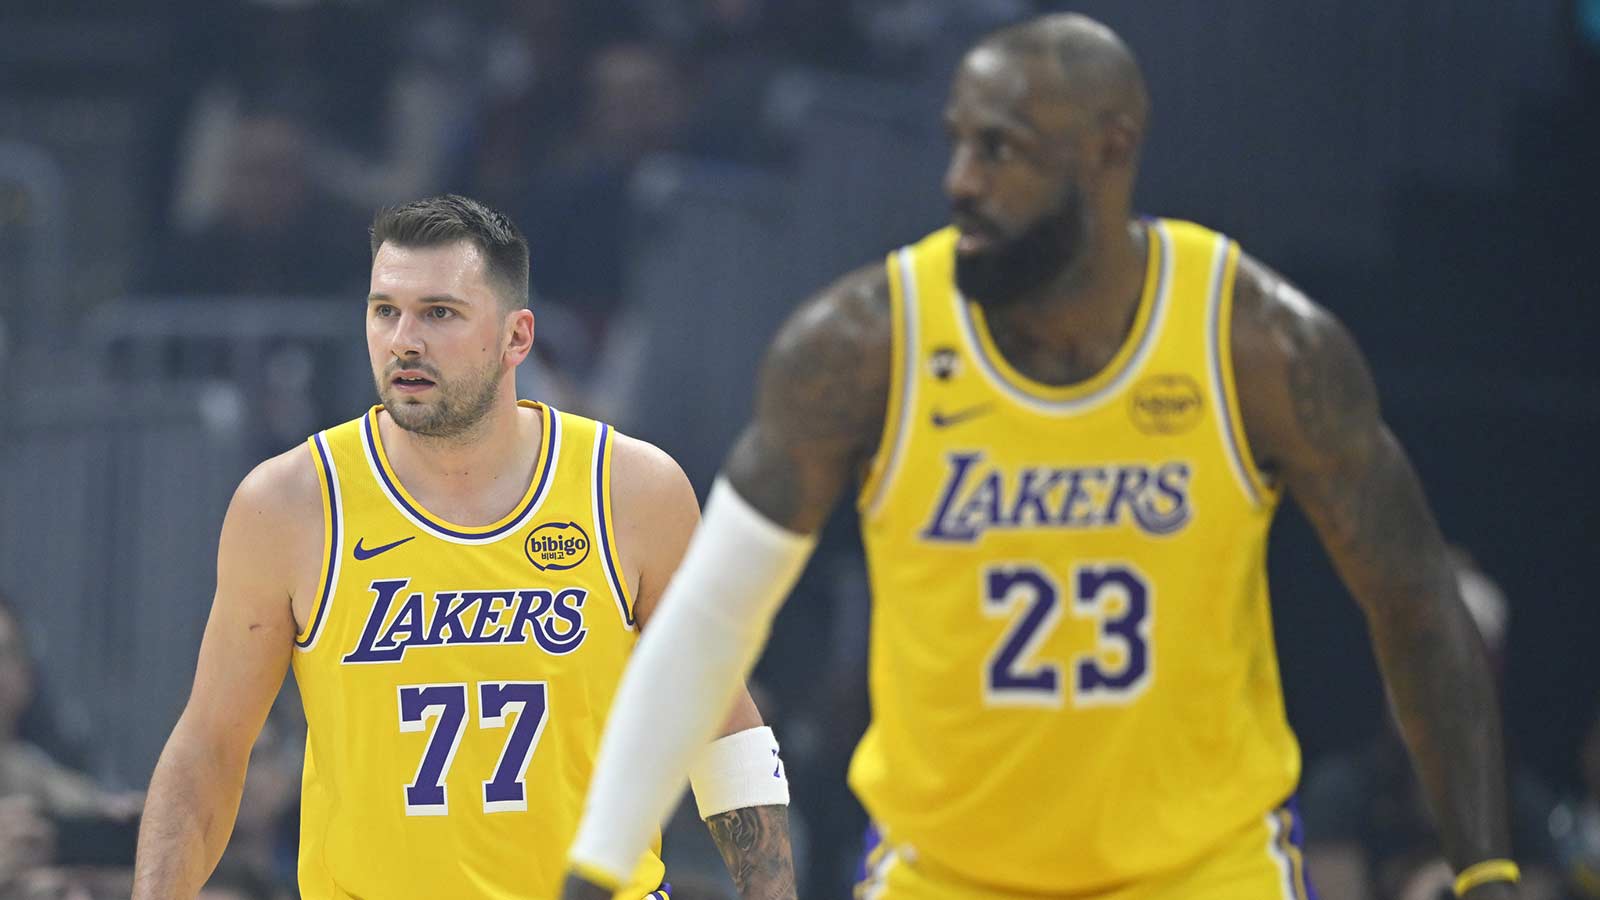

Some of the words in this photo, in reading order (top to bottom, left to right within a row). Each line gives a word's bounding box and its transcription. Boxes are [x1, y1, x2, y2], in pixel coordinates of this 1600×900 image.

[920, 450, 1193, 543] LAKERS
[530, 535, 587, 556] bibigo
[541, 551, 565, 560] 비비고
[341, 578, 589, 665] LAKERS
[982, 562, 1153, 707] 23
[397, 681, 549, 816] 77
